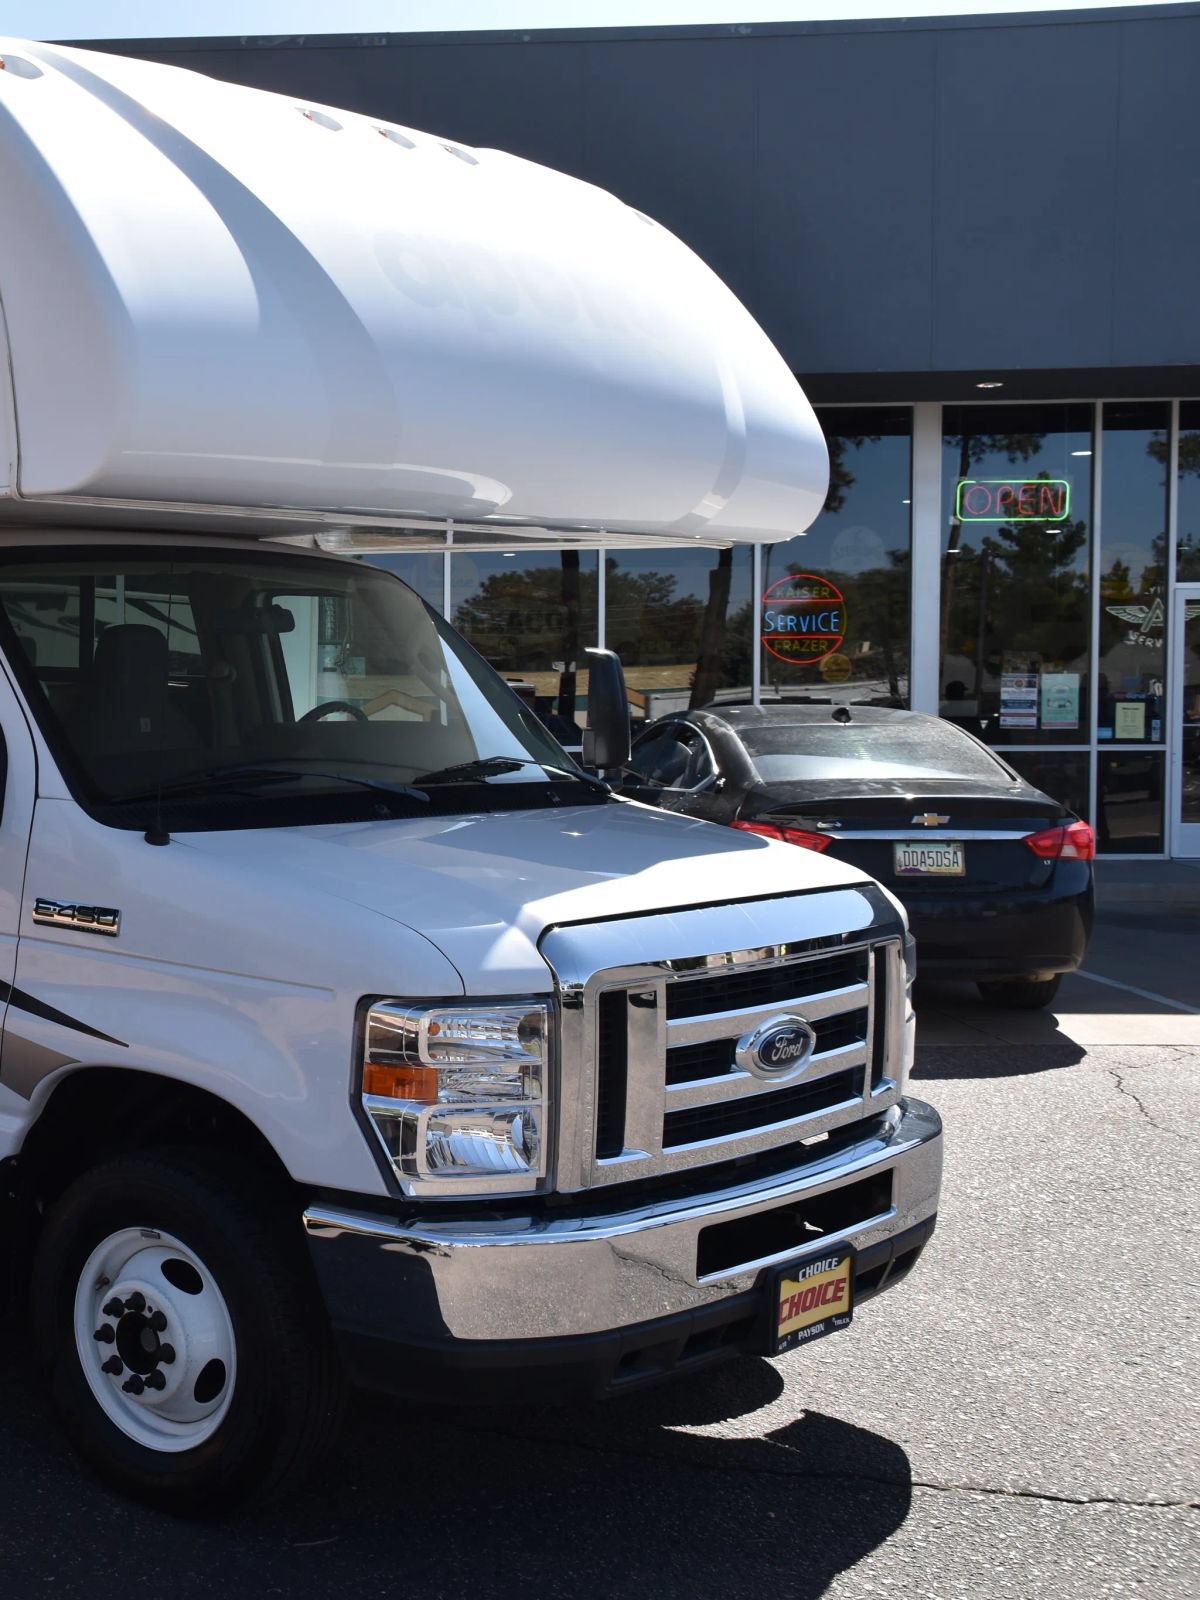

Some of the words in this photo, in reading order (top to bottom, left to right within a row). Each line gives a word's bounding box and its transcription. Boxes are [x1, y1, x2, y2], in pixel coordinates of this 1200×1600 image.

[964, 486, 1064, 515] OPEN
[775, 586, 830, 599] KAISER
[763, 610, 840, 632] SERVICE
[775, 640, 829, 652] FRAZER
[903, 850, 959, 868] DDA5DSA
[772, 1034, 803, 1060] Ford
[799, 1258, 838, 1281] CHOICE
[778, 1278, 847, 1325] CHOICE
[798, 1322, 825, 1340] PAYSON
